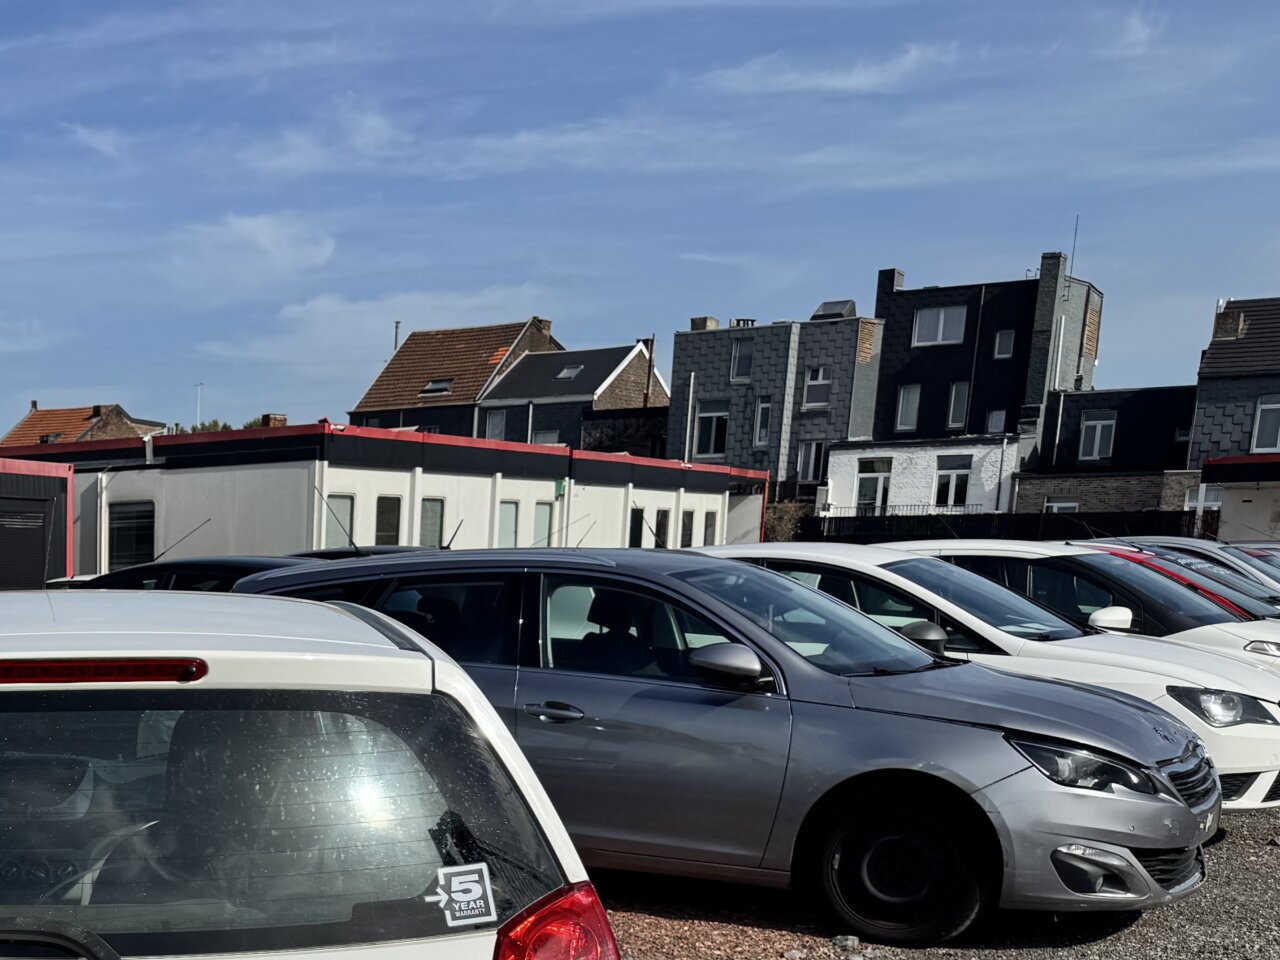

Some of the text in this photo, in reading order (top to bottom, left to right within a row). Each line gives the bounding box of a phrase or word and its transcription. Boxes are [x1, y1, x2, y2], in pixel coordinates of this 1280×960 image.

[450, 874, 483, 901] 5
[452, 899, 485, 911] YEAR
[454, 907, 486, 918] WARRANTY
